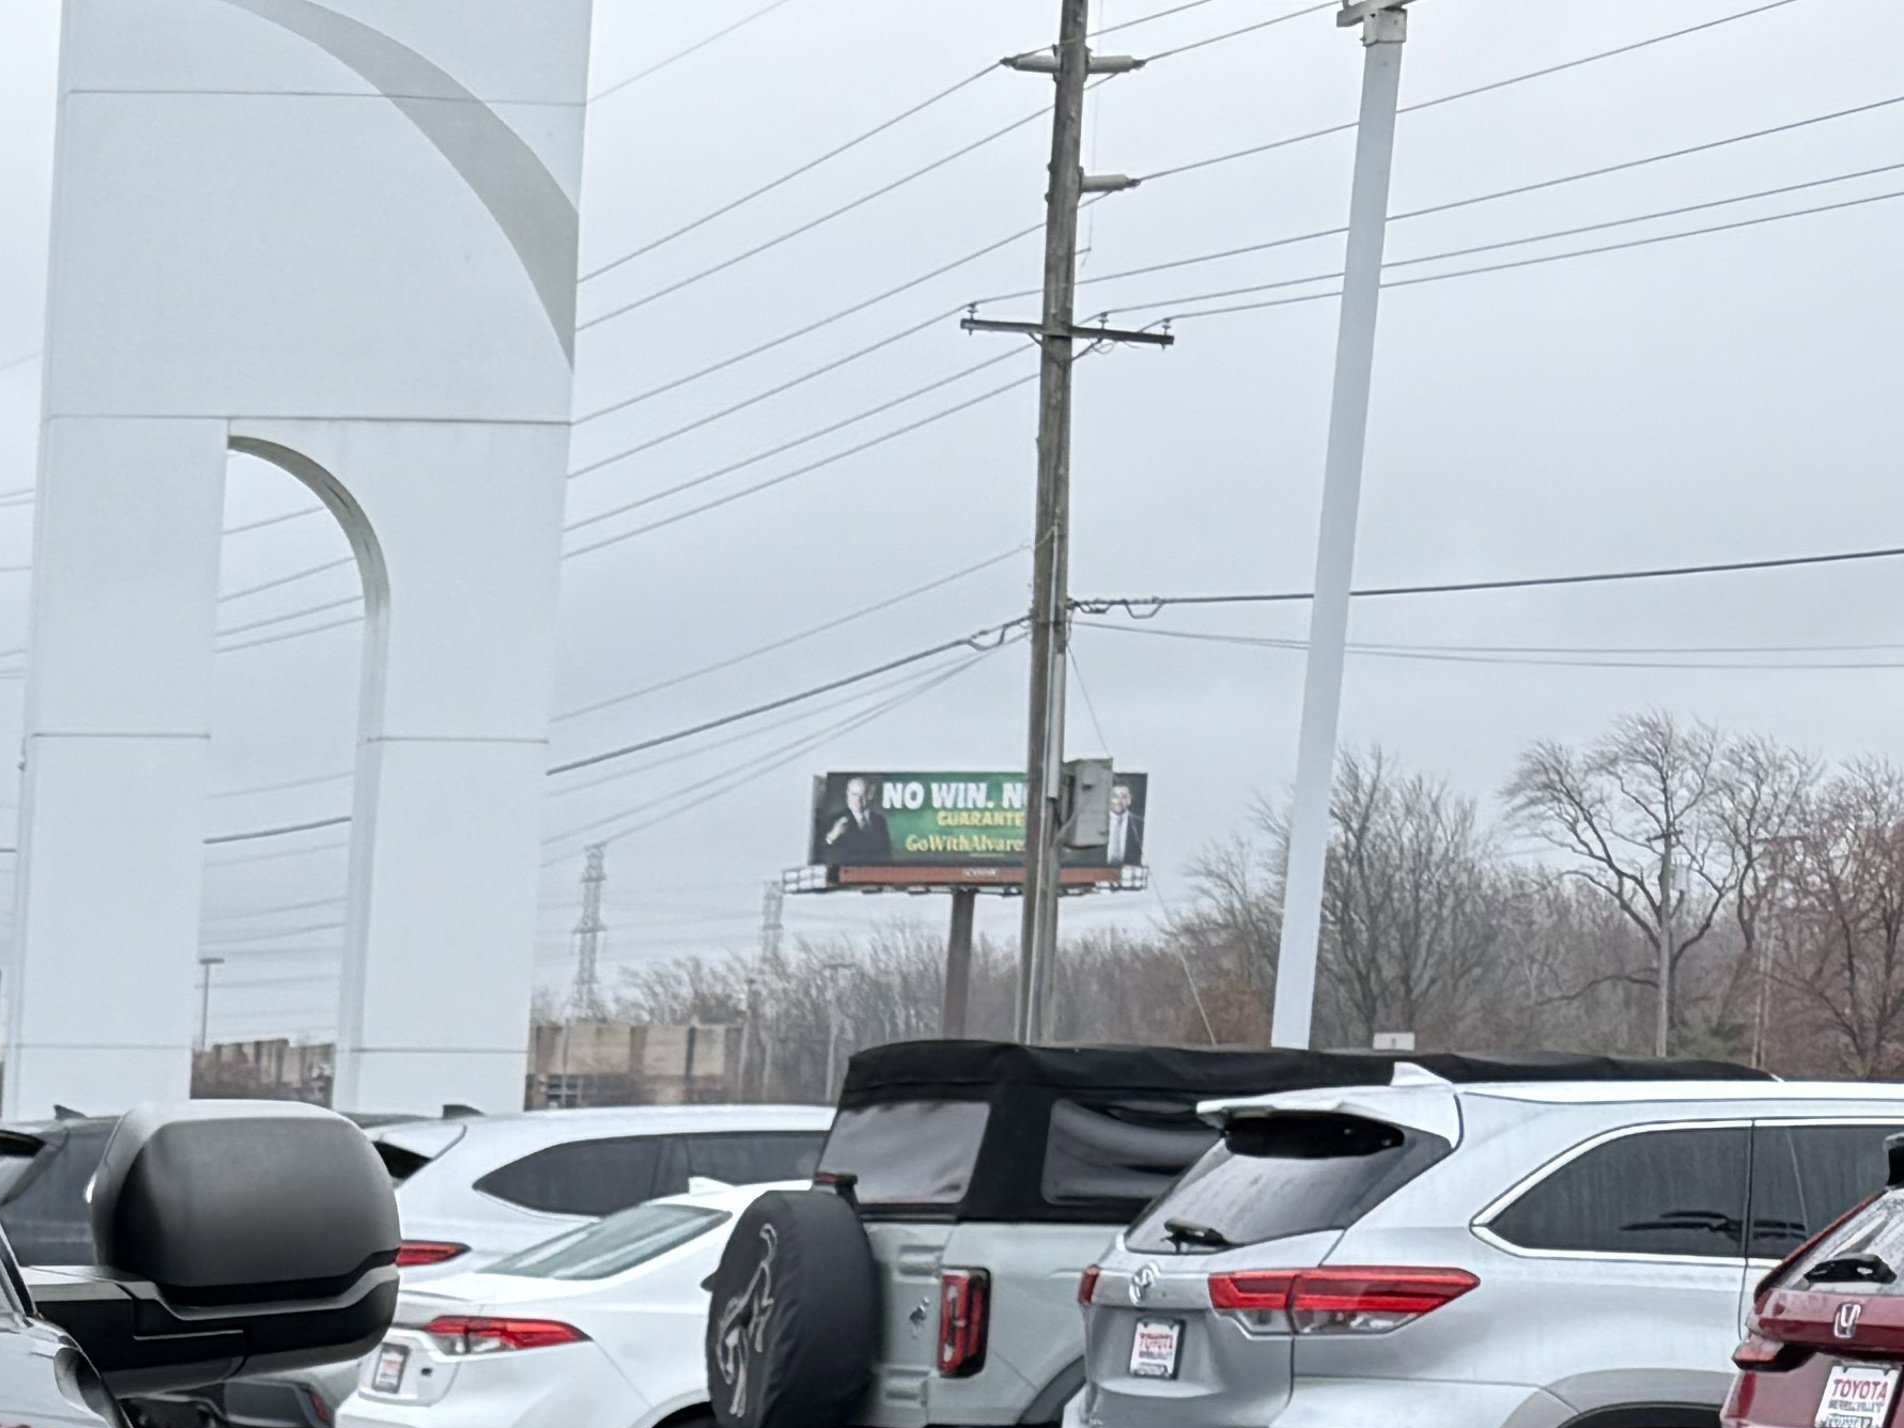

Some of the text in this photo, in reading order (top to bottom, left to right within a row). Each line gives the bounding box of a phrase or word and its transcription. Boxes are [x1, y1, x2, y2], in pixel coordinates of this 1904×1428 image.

[882, 781, 925, 810] NO
[931, 782, 994, 809] WIN.
[1832, 1379, 1889, 1400] TOYOTA
